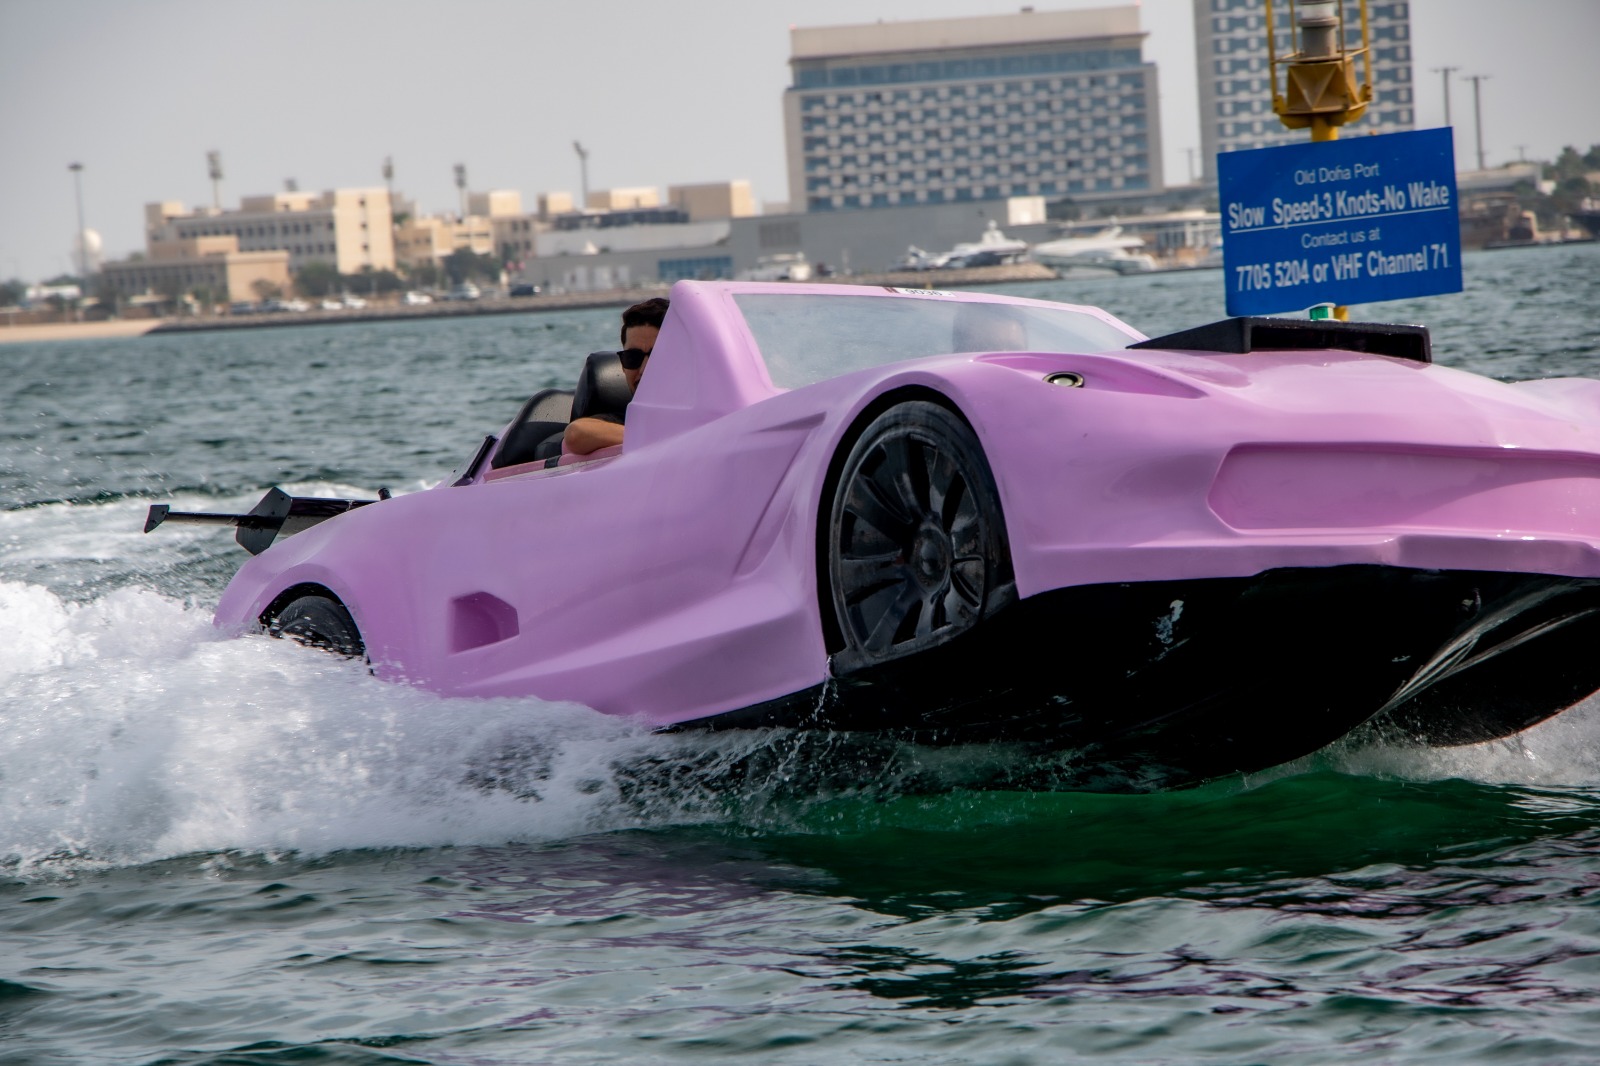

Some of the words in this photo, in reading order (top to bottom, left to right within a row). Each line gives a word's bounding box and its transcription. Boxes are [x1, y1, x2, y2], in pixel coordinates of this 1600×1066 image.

[1294, 169, 1316, 185] Old
[1319, 165, 1351, 183] Doha
[1354, 162, 1380, 178] Port
[1228, 203, 1265, 229] Slow
[1408, 181, 1450, 208] Wake
[1301, 230, 1348, 249] Contact
[1351, 231, 1366, 243] us
[1368, 227, 1381, 241] at
[1236, 264, 1272, 291] 7705
[1275, 259, 1309, 287] 5204
[1312, 264, 1328, 283] or
[1331, 253, 1362, 281] VHF
[1366, 246, 1428, 277] Channel
[1431, 243, 1448, 269] 71
